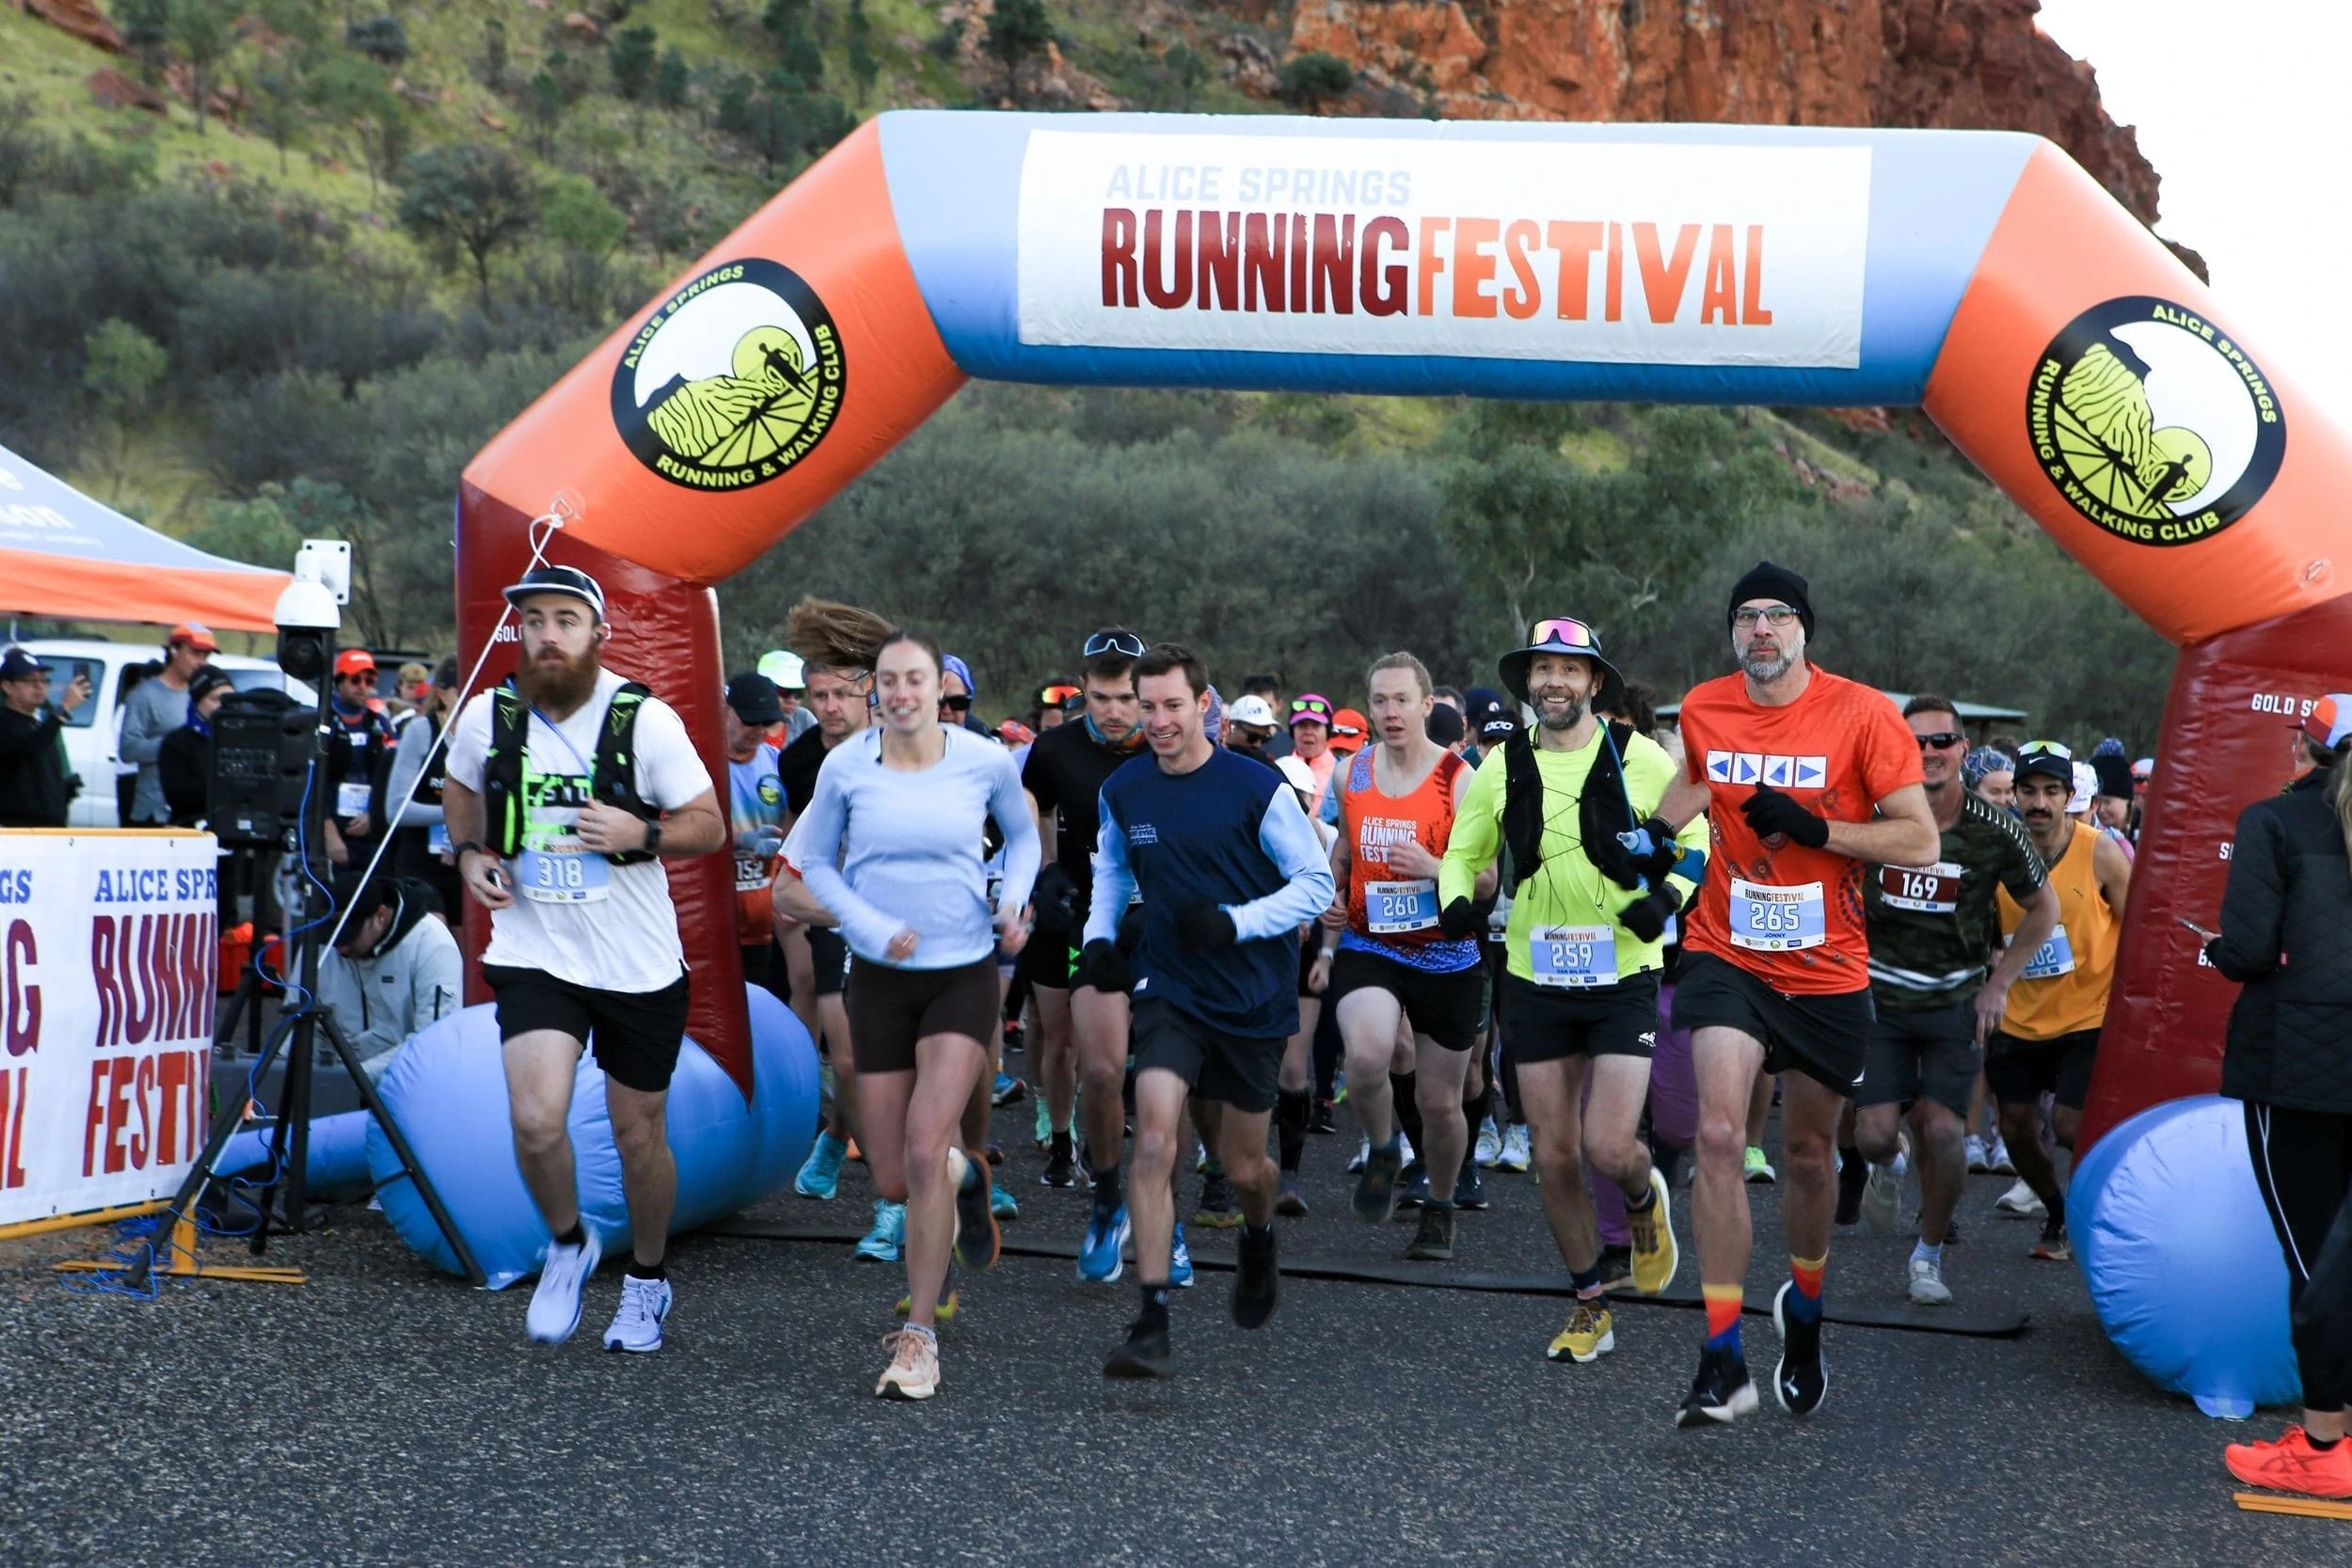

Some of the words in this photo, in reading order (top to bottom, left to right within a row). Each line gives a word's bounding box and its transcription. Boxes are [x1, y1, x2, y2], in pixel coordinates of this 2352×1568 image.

[1104, 163, 1222, 204] ALICE
[1237, 166, 1412, 207] SPRINGS
[623, 314, 665, 370] ALICE
[665, 264, 745, 314] SPRINGS
[2152, 304, 2216, 341] ALICE
[2217, 339, 2278, 424] SPRINGS
[656, 452, 756, 488] RUNNING
[761, 461, 777, 477] &
[776, 386, 840, 467] WALKING
[814, 324, 842, 381] CLUB
[2031, 358, 2062, 461] RUNNING
[2049, 465, 2066, 481] &
[2063, 480, 2155, 540] WALKING
[2159, 510, 2221, 541] CLUB
[2251, 693, 2296, 716] GOLD
[1362, 816, 1383, 828] ALICE
[1385, 818, 1417, 829] SPRINGS
[94, 868, 168, 903] ALICE
[537, 856, 583, 888] 318
[736, 859, 764, 881] 152
[1902, 872, 1939, 900] 169
[1382, 895, 1419, 918] 260
[1750, 901, 1801, 931] 265
[1549, 942, 1593, 968] 259
[0, 918, 41, 1057] G
